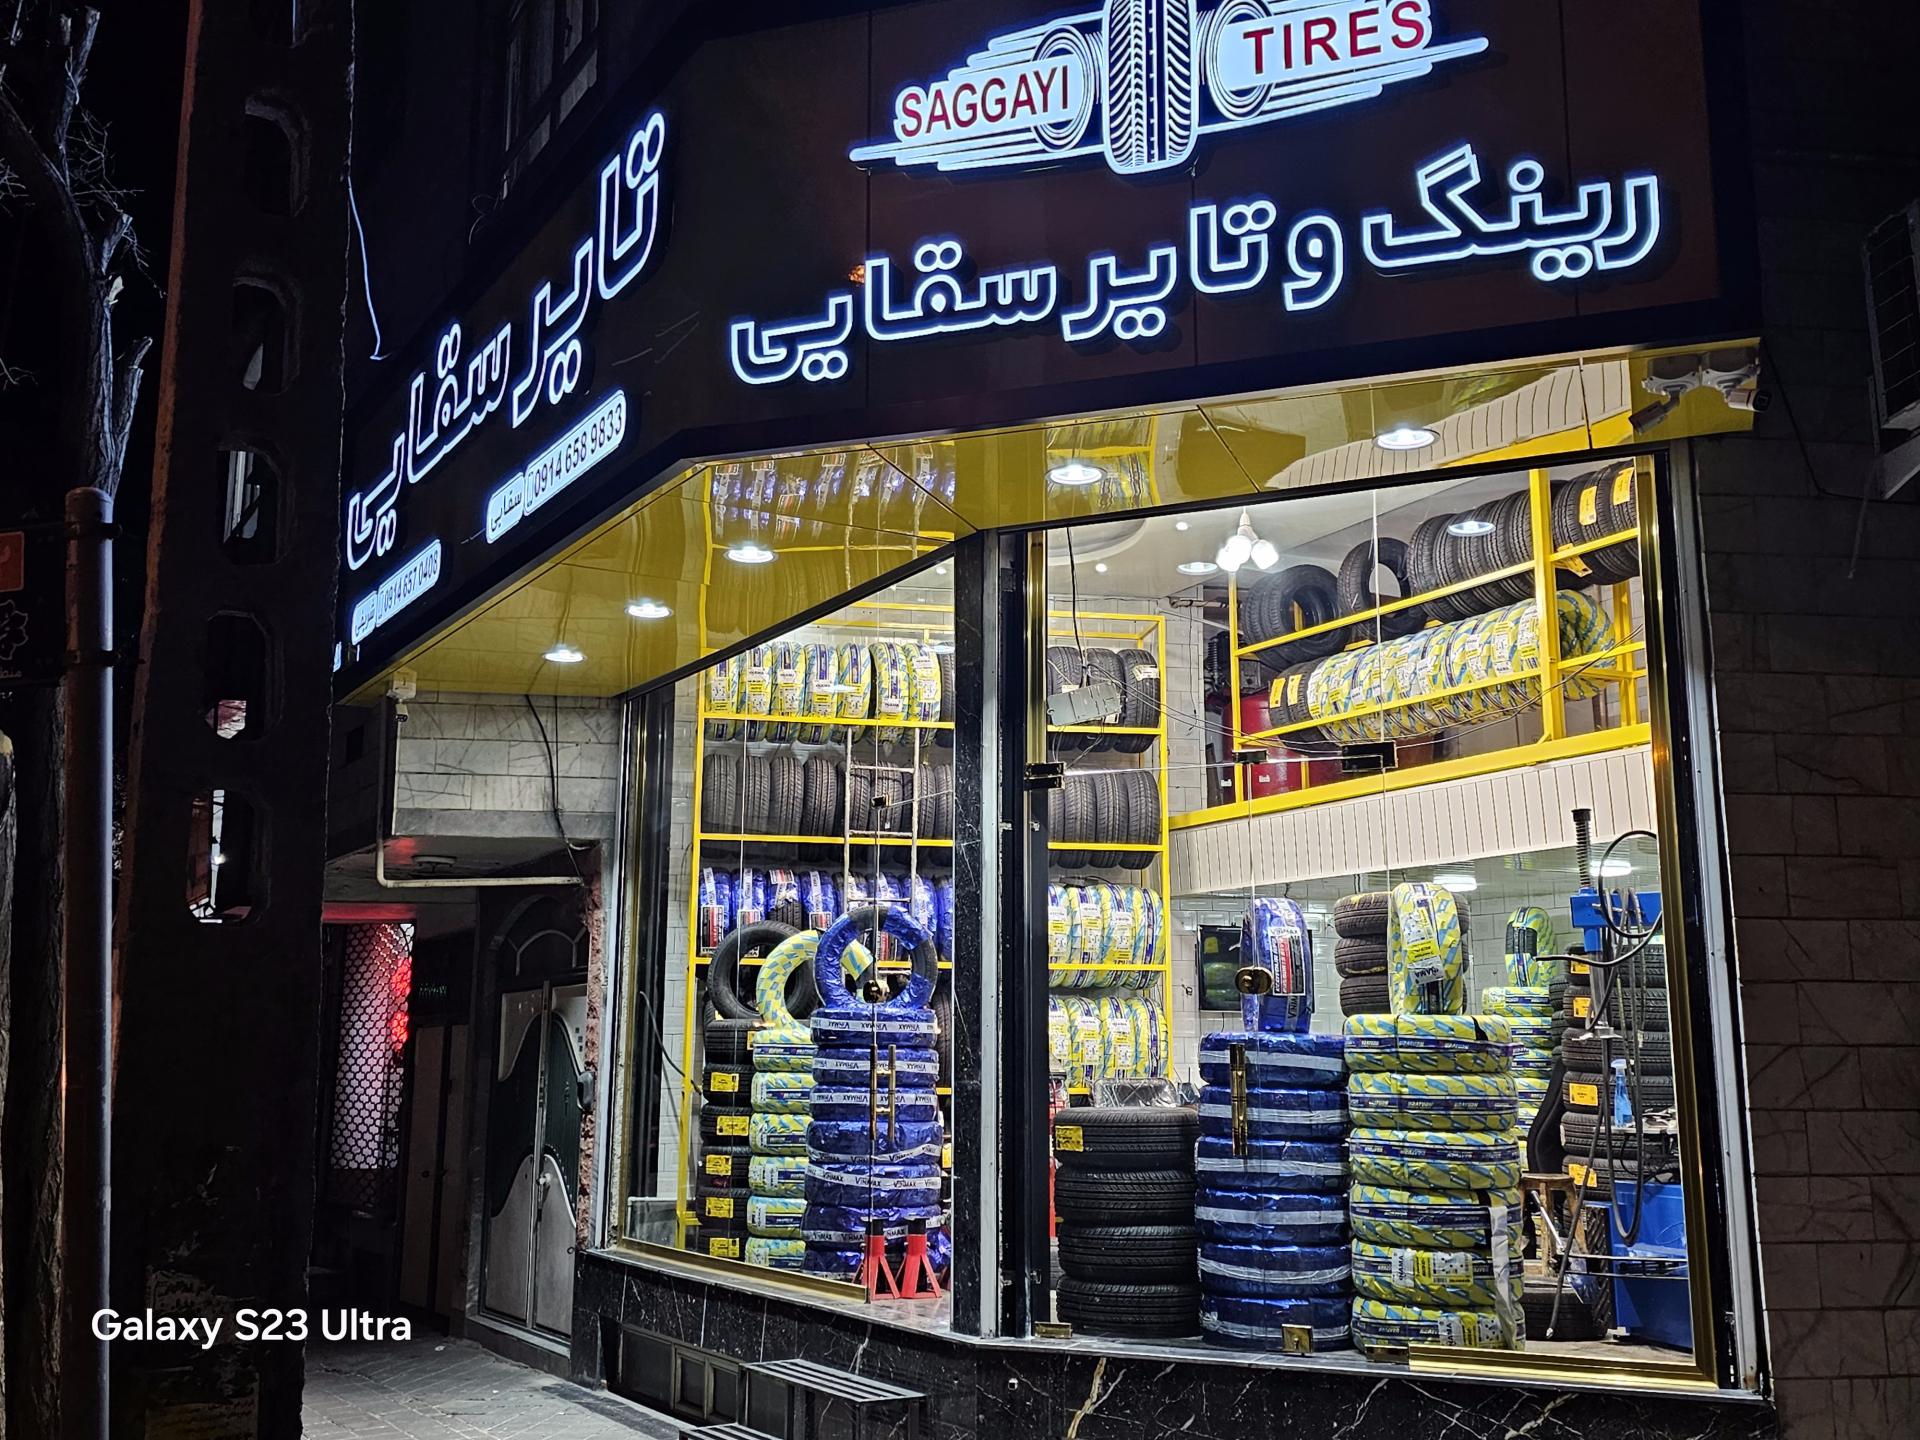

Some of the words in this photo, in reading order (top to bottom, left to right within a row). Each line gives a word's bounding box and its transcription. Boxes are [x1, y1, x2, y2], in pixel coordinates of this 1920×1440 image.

[900, 64, 1070, 138] SAGGAYI
[1243, 1, 1425, 75] TIRES
[512, 112, 666, 429] تایر
[1061, 200, 1277, 342] تایر
[1362, 143, 1660, 282] رینگ
[534, 450, 562, 498] 0914
[565, 431, 588, 474] 658
[590, 403, 622, 455] 9833
